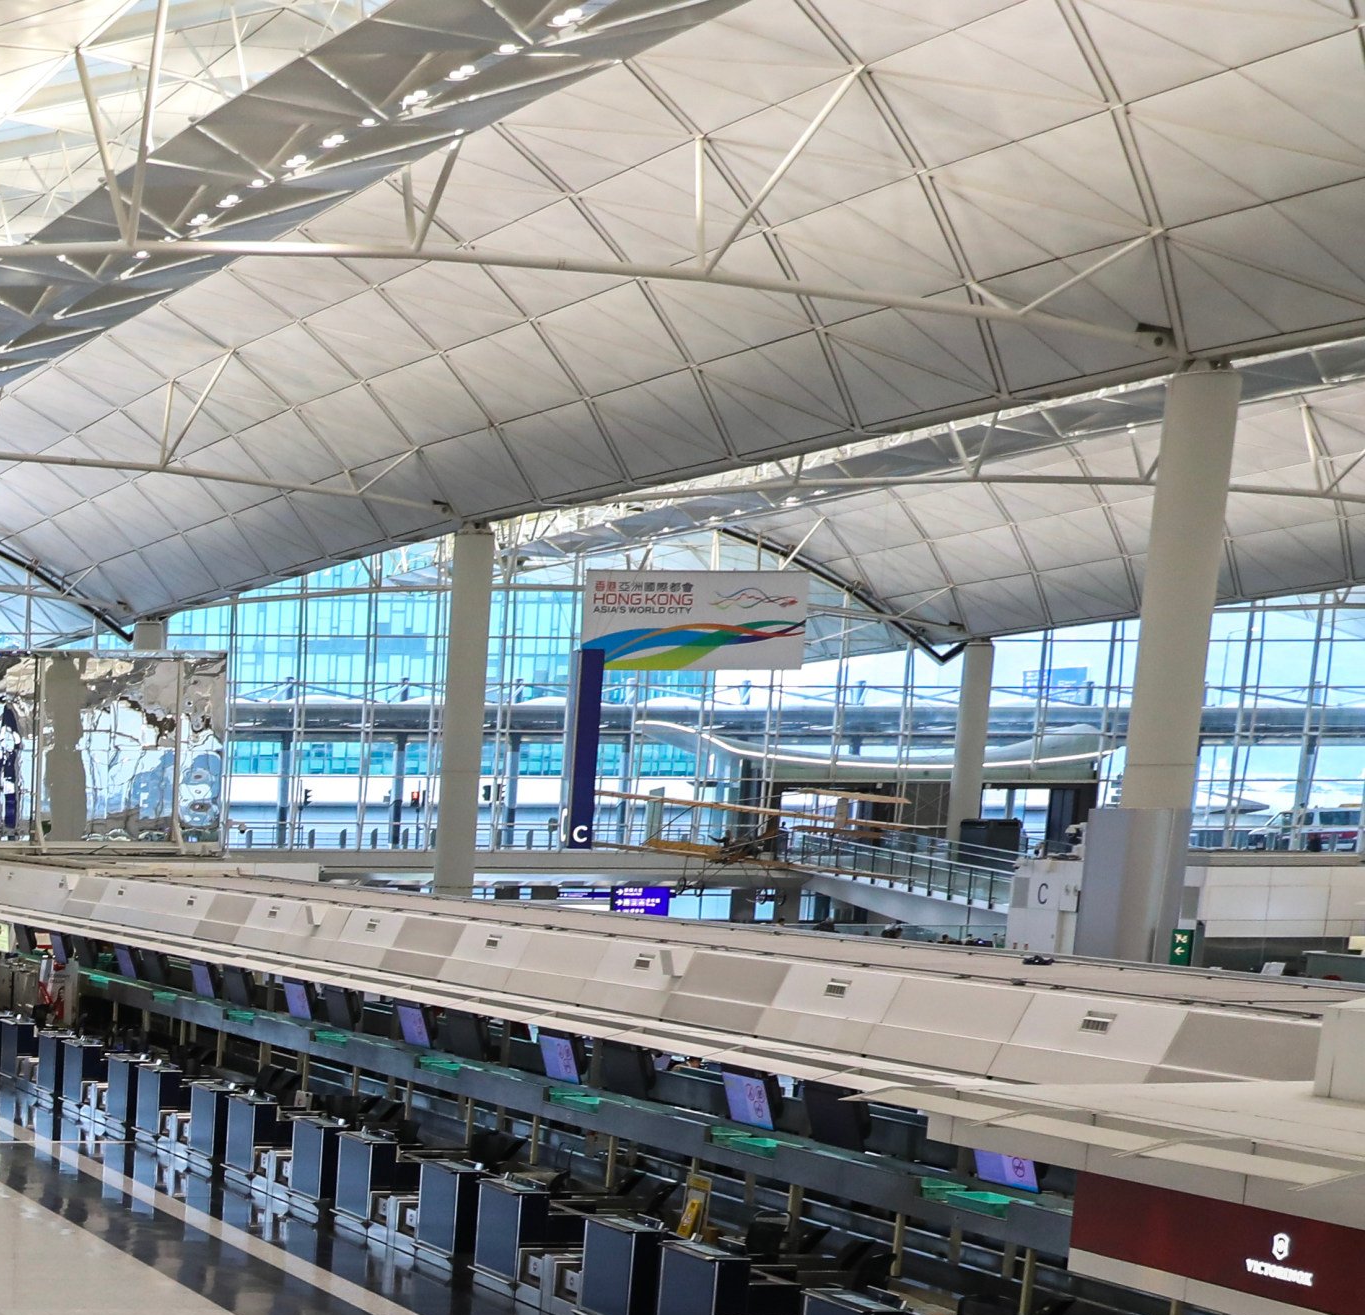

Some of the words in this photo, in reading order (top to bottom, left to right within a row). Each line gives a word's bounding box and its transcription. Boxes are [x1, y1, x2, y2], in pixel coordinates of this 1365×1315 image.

[593, 593, 642, 605] HONG
[645, 593, 694, 606] KONG
[593, 606, 626, 614] ASIA'S
[628, 606, 666, 614] WORLD
[667, 606, 692, 614] CITY
[573, 825, 588, 843] C
[1037, 883, 1049, 904] C
